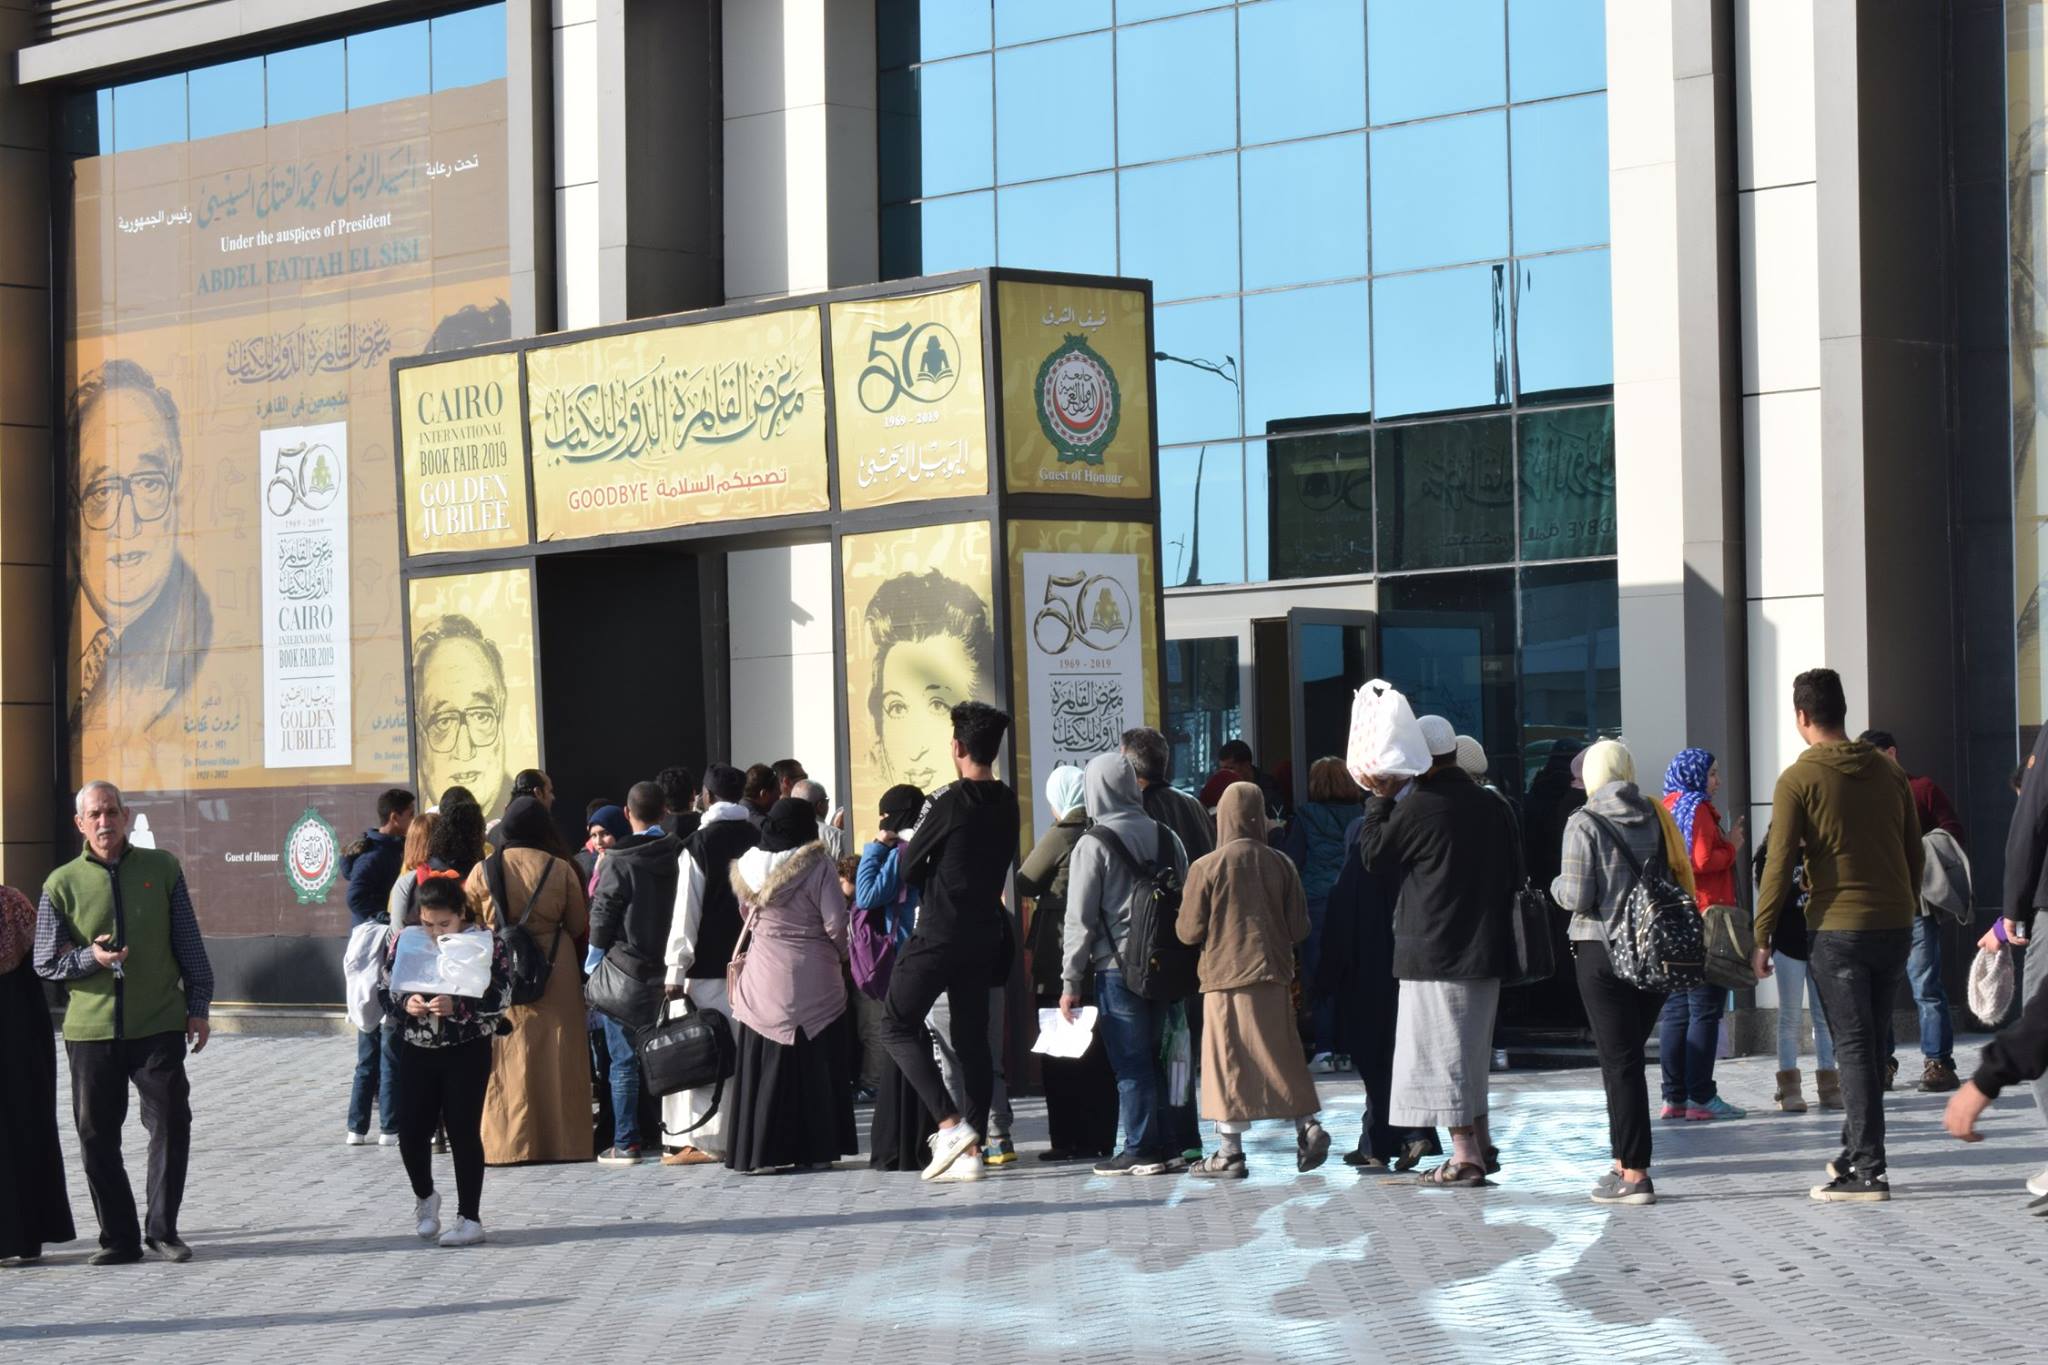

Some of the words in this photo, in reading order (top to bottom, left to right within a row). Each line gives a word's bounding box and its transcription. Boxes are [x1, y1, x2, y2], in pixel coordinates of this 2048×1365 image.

[425, 160, 452, 180] رعاية
[454, 153, 480, 173] تحت
[117, 209, 165, 234] الجمهورية
[166, 205, 193, 225] رئيس
[220, 235, 254, 252] Under
[256, 229, 274, 246] the
[276, 224, 321, 244] auspices
[323, 219, 336, 237] of
[338, 211, 392, 235] President
[198, 261, 262, 294] ABDEL
[265, 251, 344, 285] FATTAH
[350, 245, 376, 274] EL
[379, 237, 421, 267] SISI
[1041, 306, 1076, 327] الشرف
[857, 321, 962, 414] 50
[418, 381, 503, 426] CAIRO
[419, 422, 505, 446] INTERNATIONAL
[420, 447, 452, 477] BOOK
[453, 448, 479, 473] FAIR
[482, 441, 508, 470] 2019
[267, 442, 341, 517] 50
[656, 474, 715, 498] السلامة
[716, 468, 788, 493] تصحبكم
[1039, 467, 1069, 482] Guest
[1071, 468, 1082, 481] of
[1084, 469, 1123, 484] Honour
[420, 473, 509, 507] GOLDEN
[568, 483, 650, 511] GOODBYE
[423, 501, 512, 541] JUBILEE
[278, 604, 333, 632] CAIRO
[1034, 570, 1132, 655] 50
[278, 633, 333, 646] INTERNATIONAL
[279, 649, 298, 668] BOOK
[300, 648, 317, 666] FAIR
[318, 647, 334, 665] 2019
[1059, 659, 1080, 669] 1969
[1090, 659, 1112, 668] 2019
[280, 709, 335, 729] GOLDEN
[280, 728, 336, 752] JUBILEE
[225, 852, 244, 862] Guest
[245, 853, 252, 861] of
[254, 852, 279, 862] Honour
